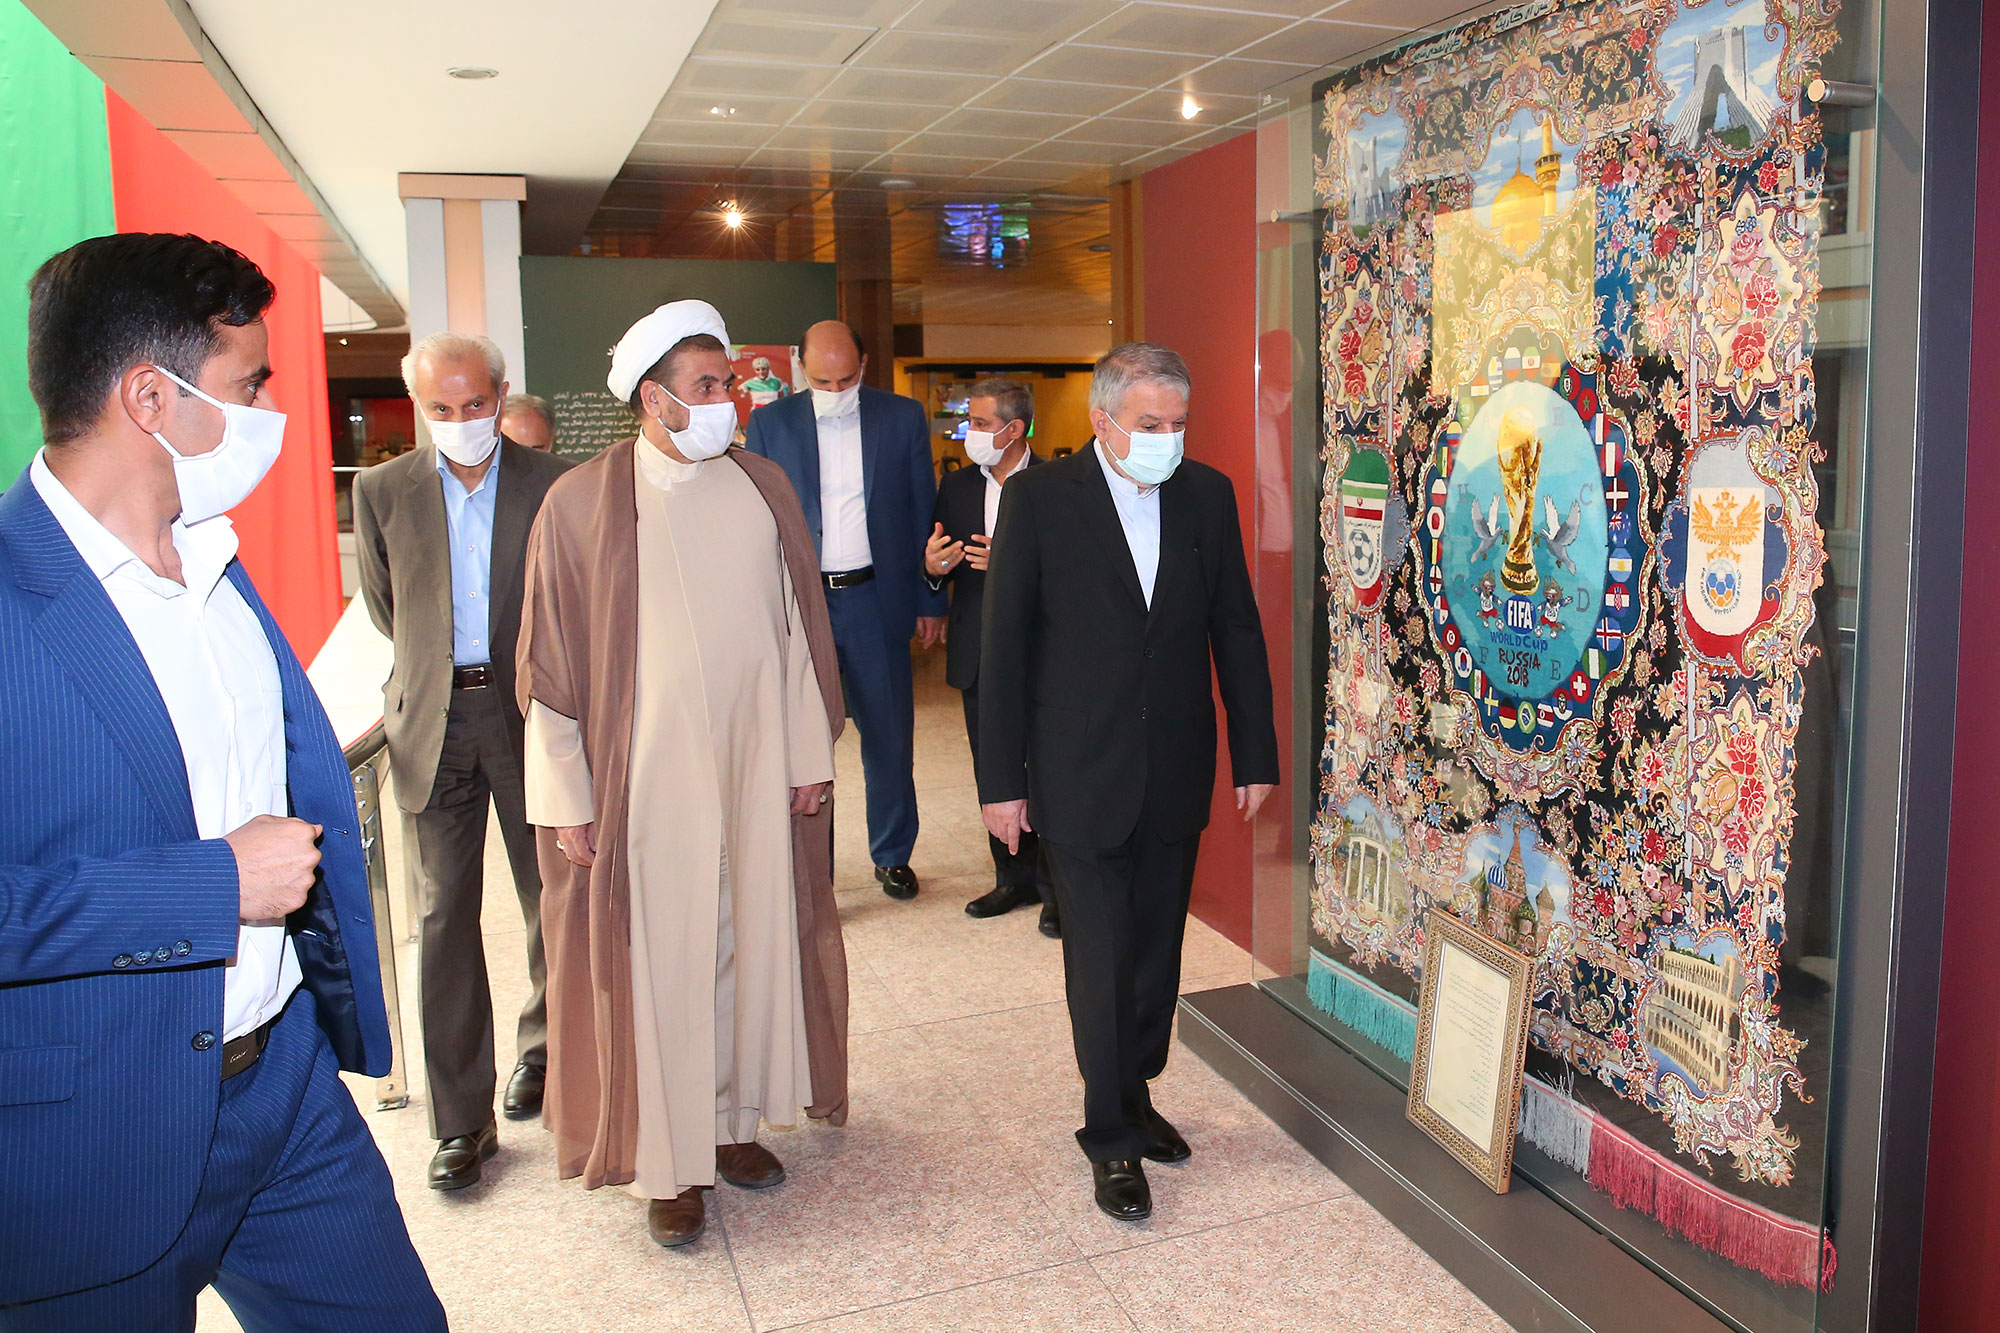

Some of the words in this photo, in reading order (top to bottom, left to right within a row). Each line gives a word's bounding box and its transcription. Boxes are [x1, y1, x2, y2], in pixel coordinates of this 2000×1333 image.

[1579, 482, 1593, 506] C
[1576, 587, 1590, 612] D
[1507, 599, 1533, 630] FIFA
[1490, 631, 1521, 647] WORLD
[1498, 647, 1541, 670] RUSSIA
[1550, 659, 1561, 680] E
[1507, 665, 1529, 688] 2018
